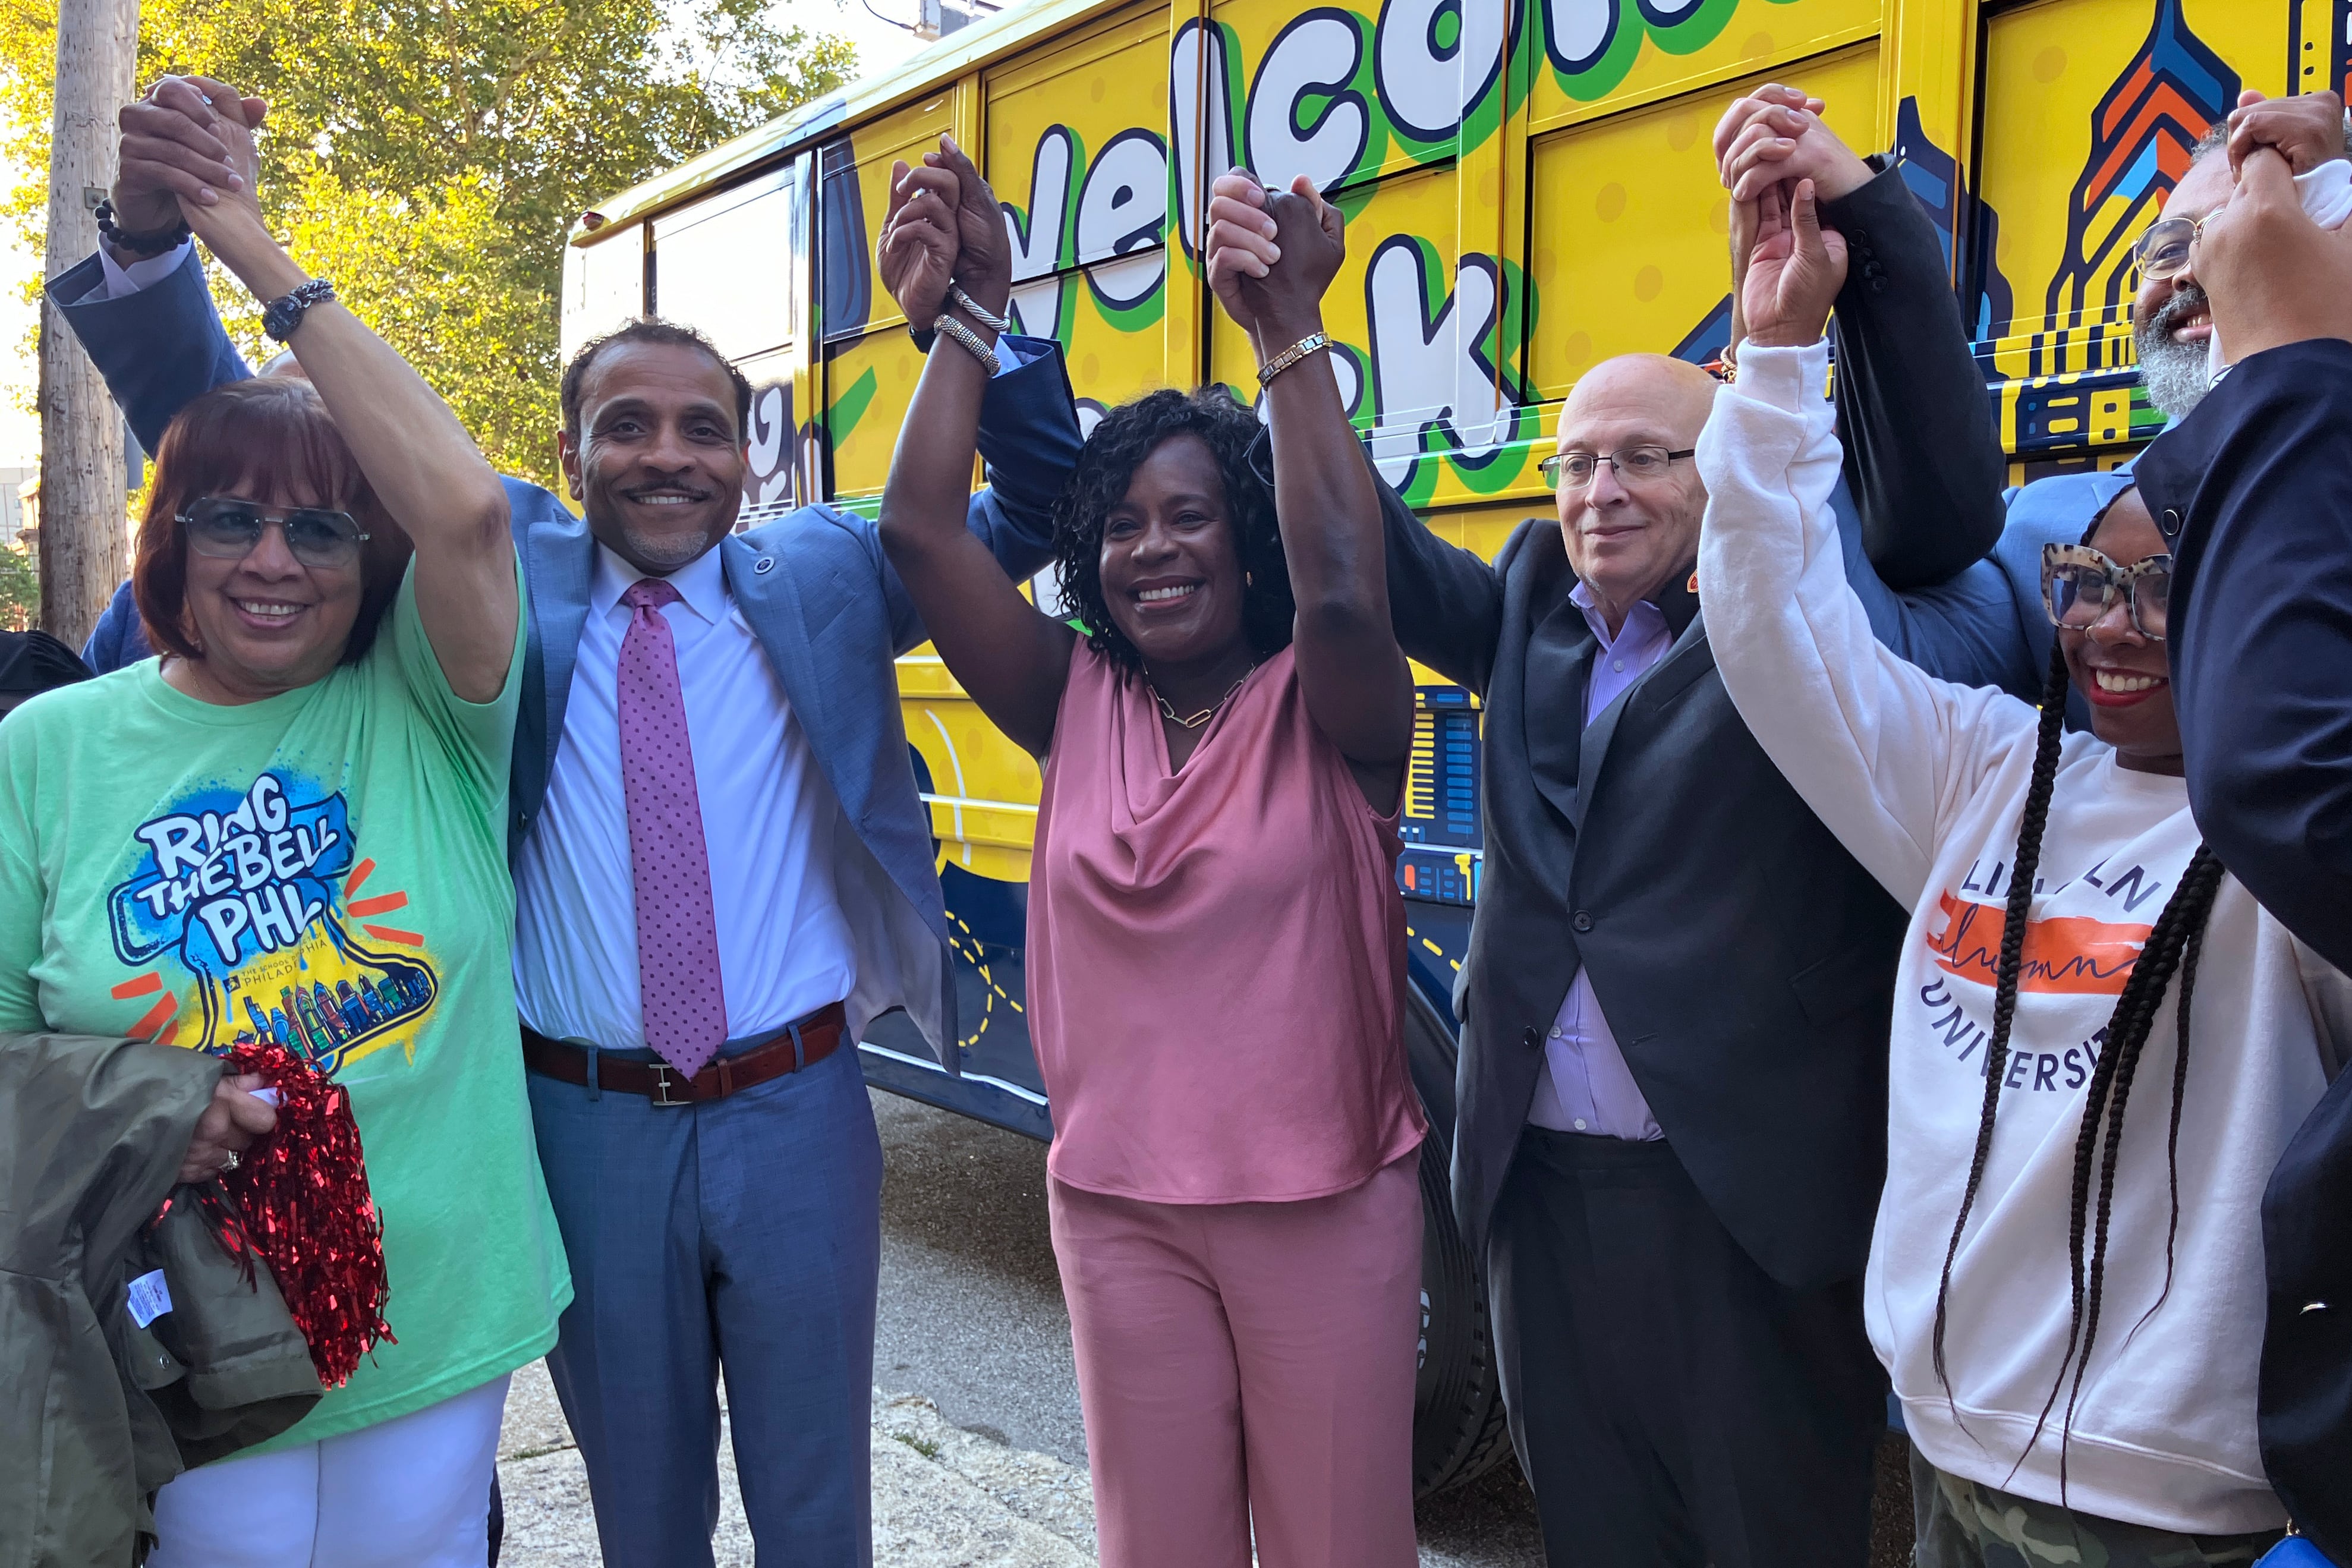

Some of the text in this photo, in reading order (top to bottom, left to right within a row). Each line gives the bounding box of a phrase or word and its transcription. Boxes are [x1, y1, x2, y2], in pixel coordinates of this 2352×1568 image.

[136, 817, 339, 917] THE BELL
[1961, 855, 2162, 914] LILN
[199, 884, 324, 962] PHL
[1920, 976, 2109, 1092] UNIERSI
